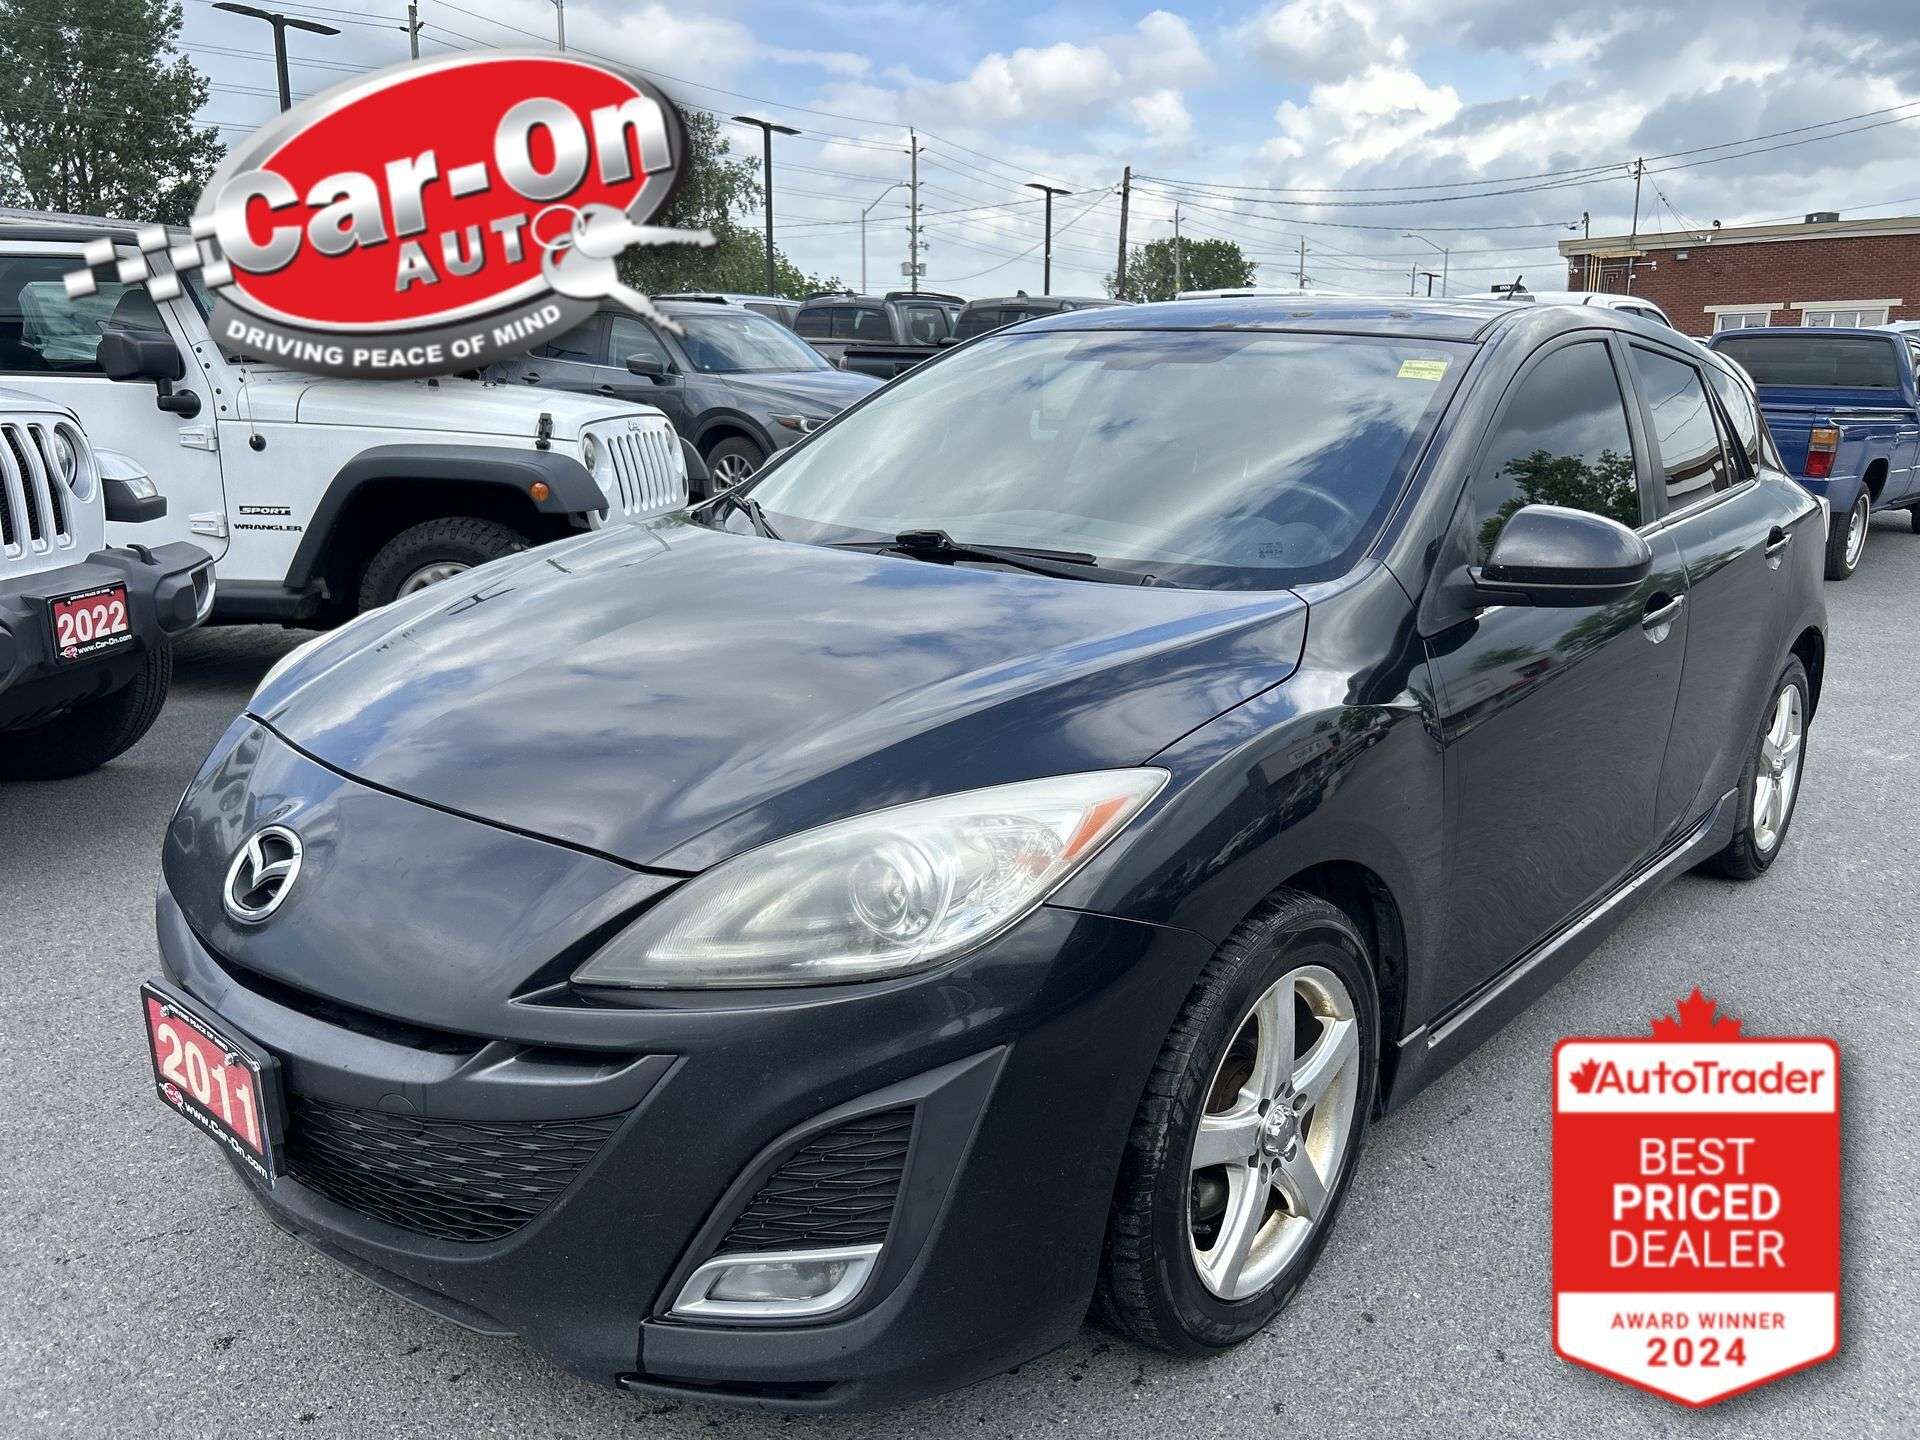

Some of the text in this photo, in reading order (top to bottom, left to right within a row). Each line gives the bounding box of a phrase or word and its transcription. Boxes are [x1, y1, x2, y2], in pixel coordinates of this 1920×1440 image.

[240, 506, 291, 515] SPORT
[233, 523, 303, 532] WRANGLER
[57, 600, 128, 647] 2022
[78, 634, 132, 654] www.Car-On.com
[157, 1022, 258, 1148] 2011
[184, 1102, 269, 1180] www.Car-On.com
